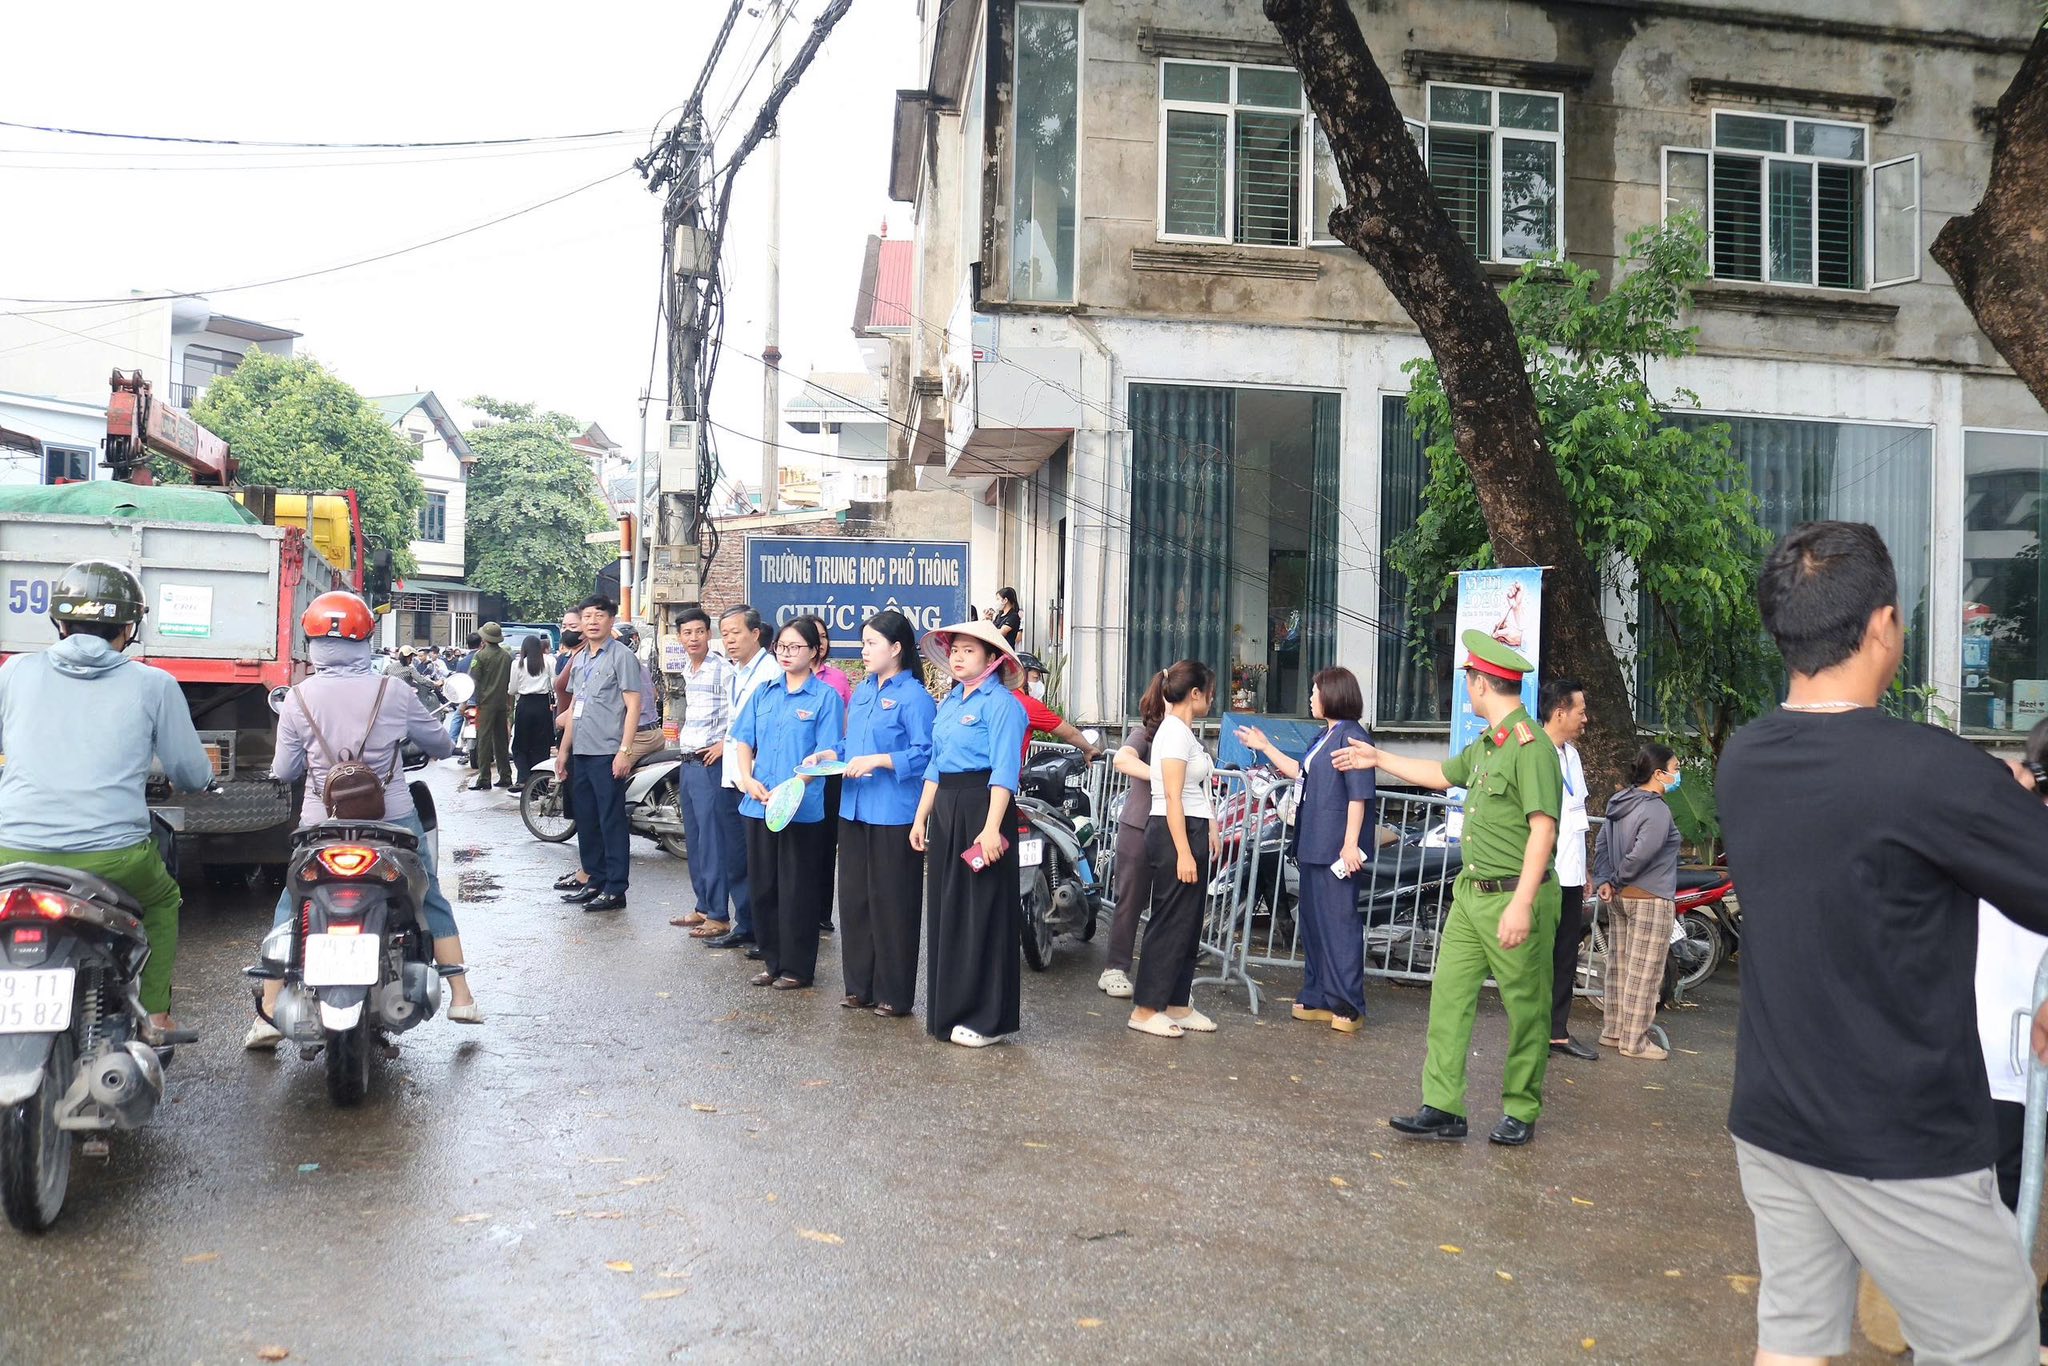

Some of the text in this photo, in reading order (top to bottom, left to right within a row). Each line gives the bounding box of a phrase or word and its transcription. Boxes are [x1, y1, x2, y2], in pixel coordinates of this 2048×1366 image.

[760, 547, 959, 592] TRƯỜNG TRUNG HỌC PHỔ THÔNG
[9, 579, 57, 614] 59
[0, 974, 57, 998] 9-T1
